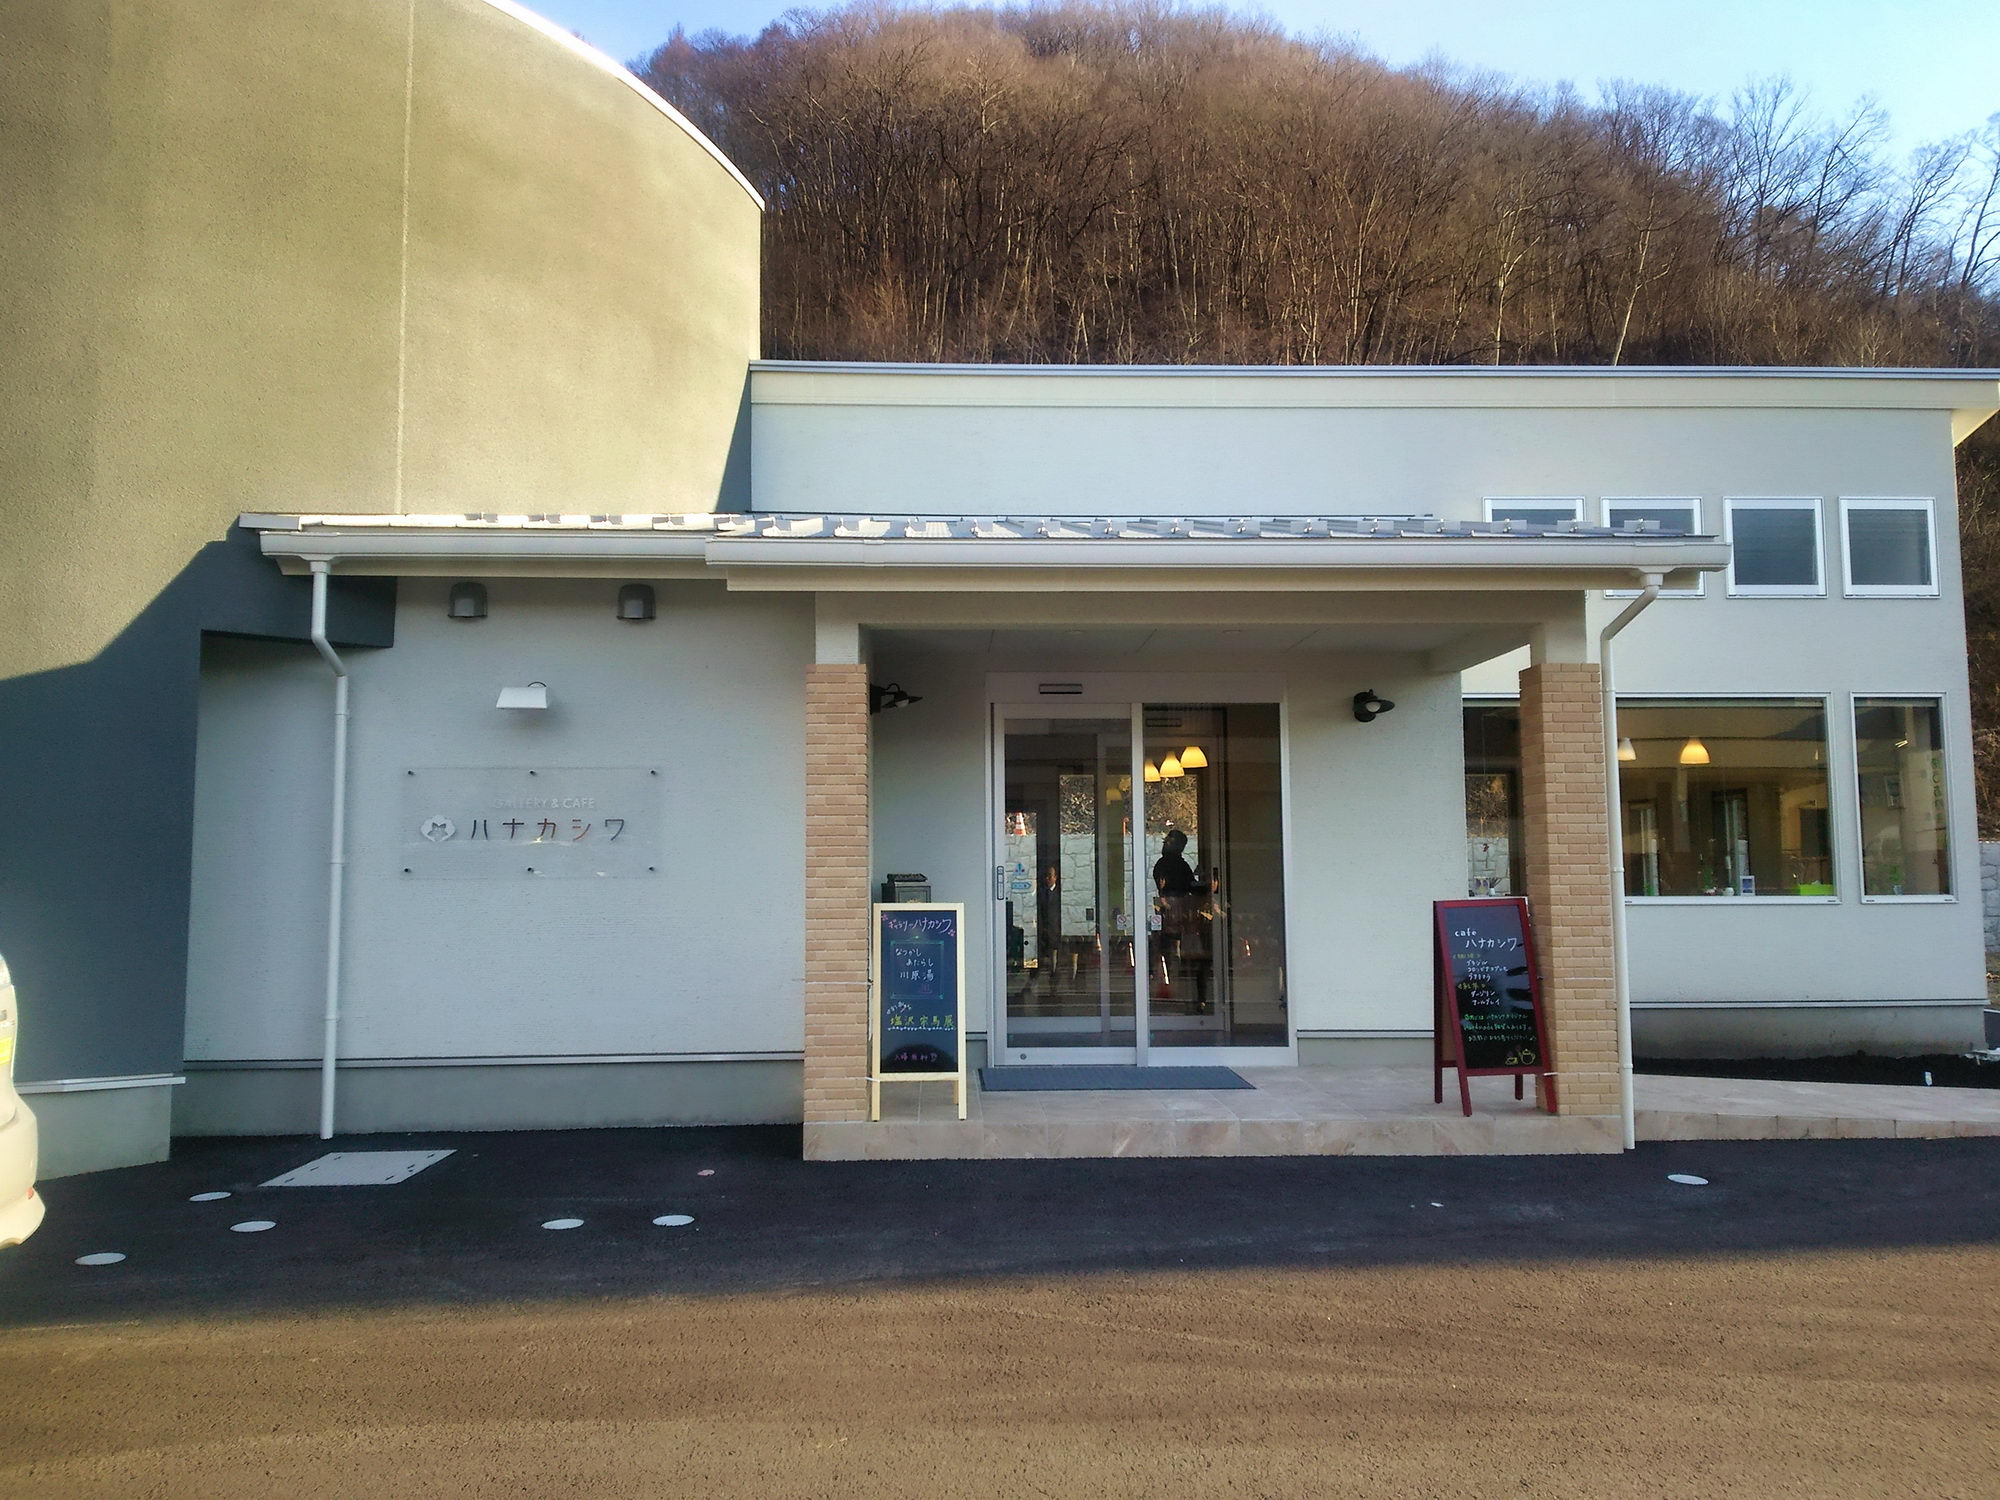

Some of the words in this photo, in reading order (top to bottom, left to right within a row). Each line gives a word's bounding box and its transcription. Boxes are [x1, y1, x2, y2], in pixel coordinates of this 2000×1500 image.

[551, 798, 560, 809] &
[563, 798, 595, 809] CAFE
[471, 818, 626, 842] ハナカシワ
[1454, 927, 1478, 938] cafe
[1464, 937, 1518, 952] ハナカシワ
[895, 947, 922, 957] なつかし
[905, 957, 934, 967] あたらし
[899, 969, 935, 982] 川原湯
